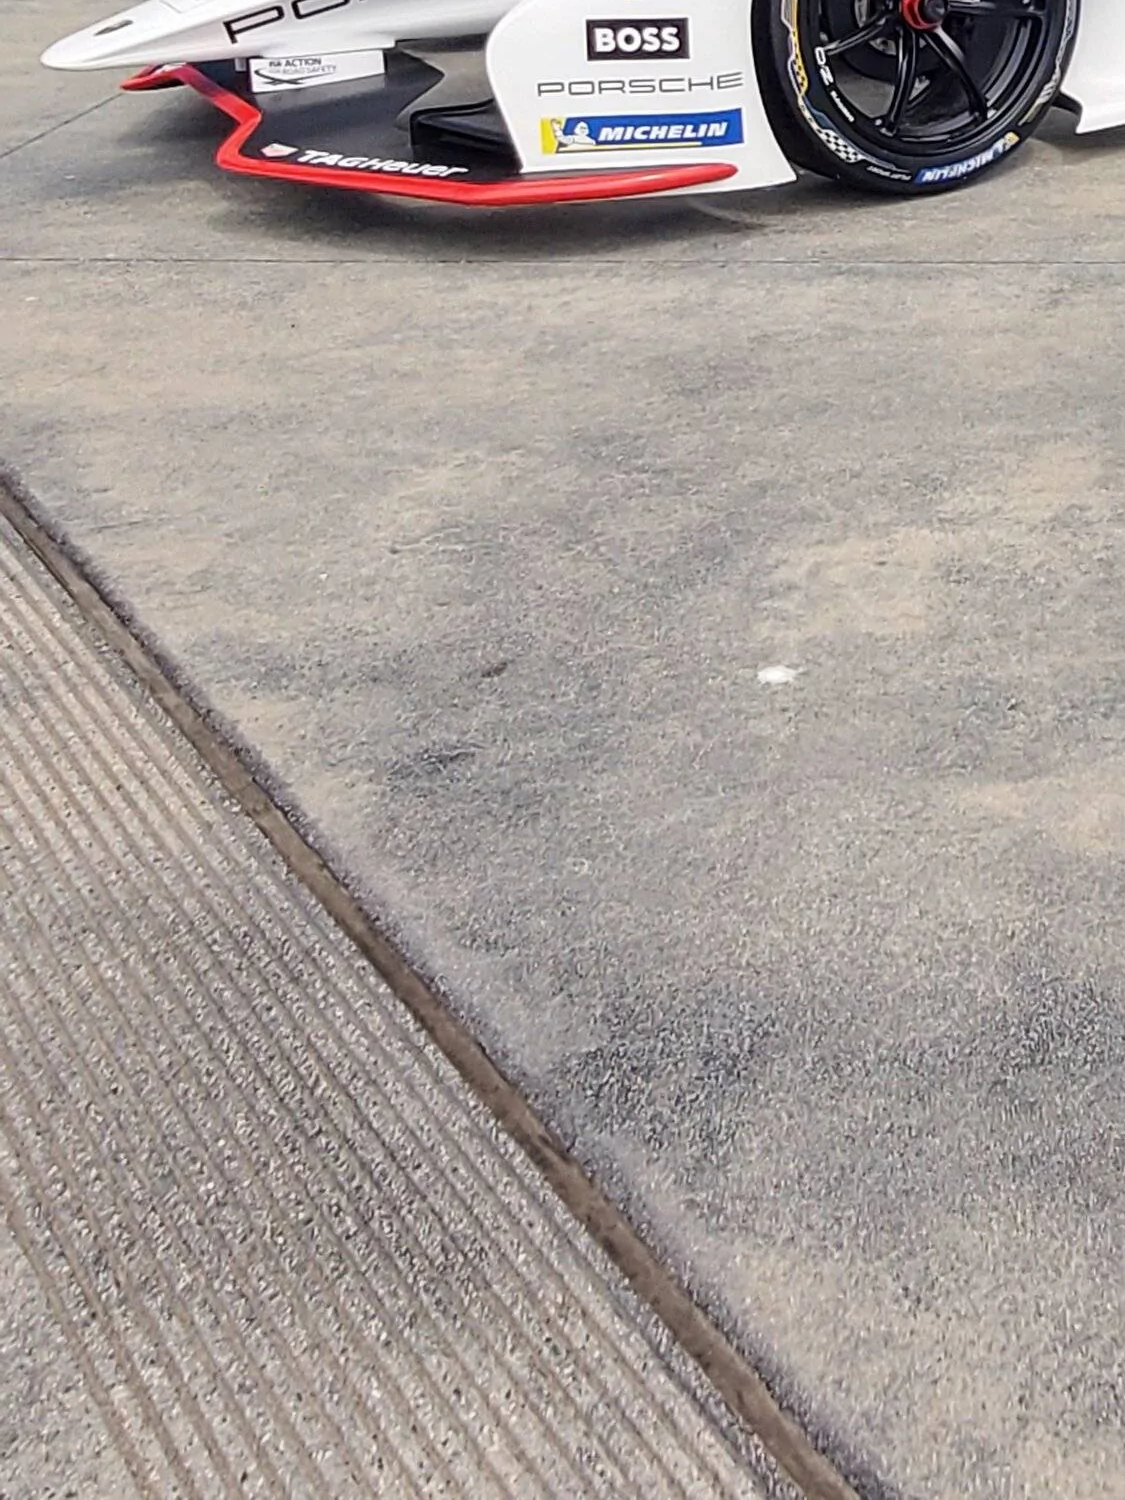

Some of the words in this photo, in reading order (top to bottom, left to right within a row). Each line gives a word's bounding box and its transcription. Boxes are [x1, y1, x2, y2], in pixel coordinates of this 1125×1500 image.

[593, 27, 681, 53] BOSS
[284, 58, 322, 67] ACTION
[537, 71, 743, 97] PORSCHE
[597, 121, 729, 142] MICHELIN
[921, 149, 995, 182] MICHELIN
